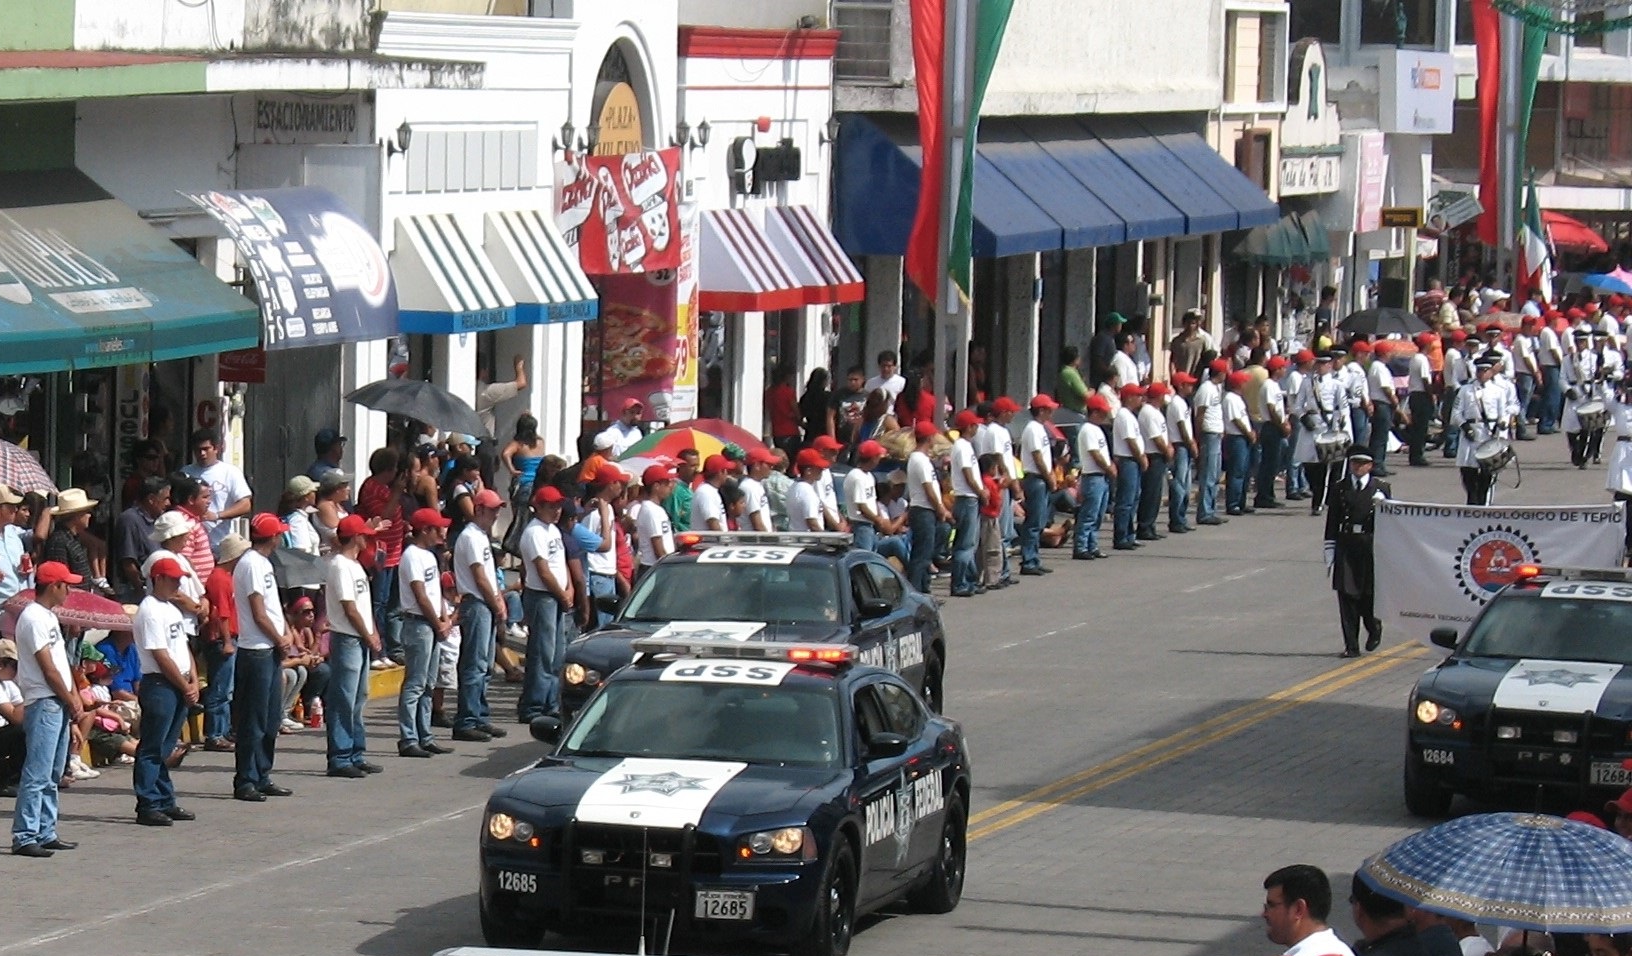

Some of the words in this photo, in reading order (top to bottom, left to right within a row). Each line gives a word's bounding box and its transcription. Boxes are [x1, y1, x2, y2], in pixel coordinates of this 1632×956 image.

[257, 99, 356, 132] ESTACIONAMIENTO
[1380, 505, 1451, 517] INSTITUTO
[1559, 511, 1579, 522] DE
[1582, 512, 1622, 523] TEPIC
[674, 665, 774, 681] SSP
[499, 870, 537, 893] 12685
[703, 901, 747, 916] 12685
